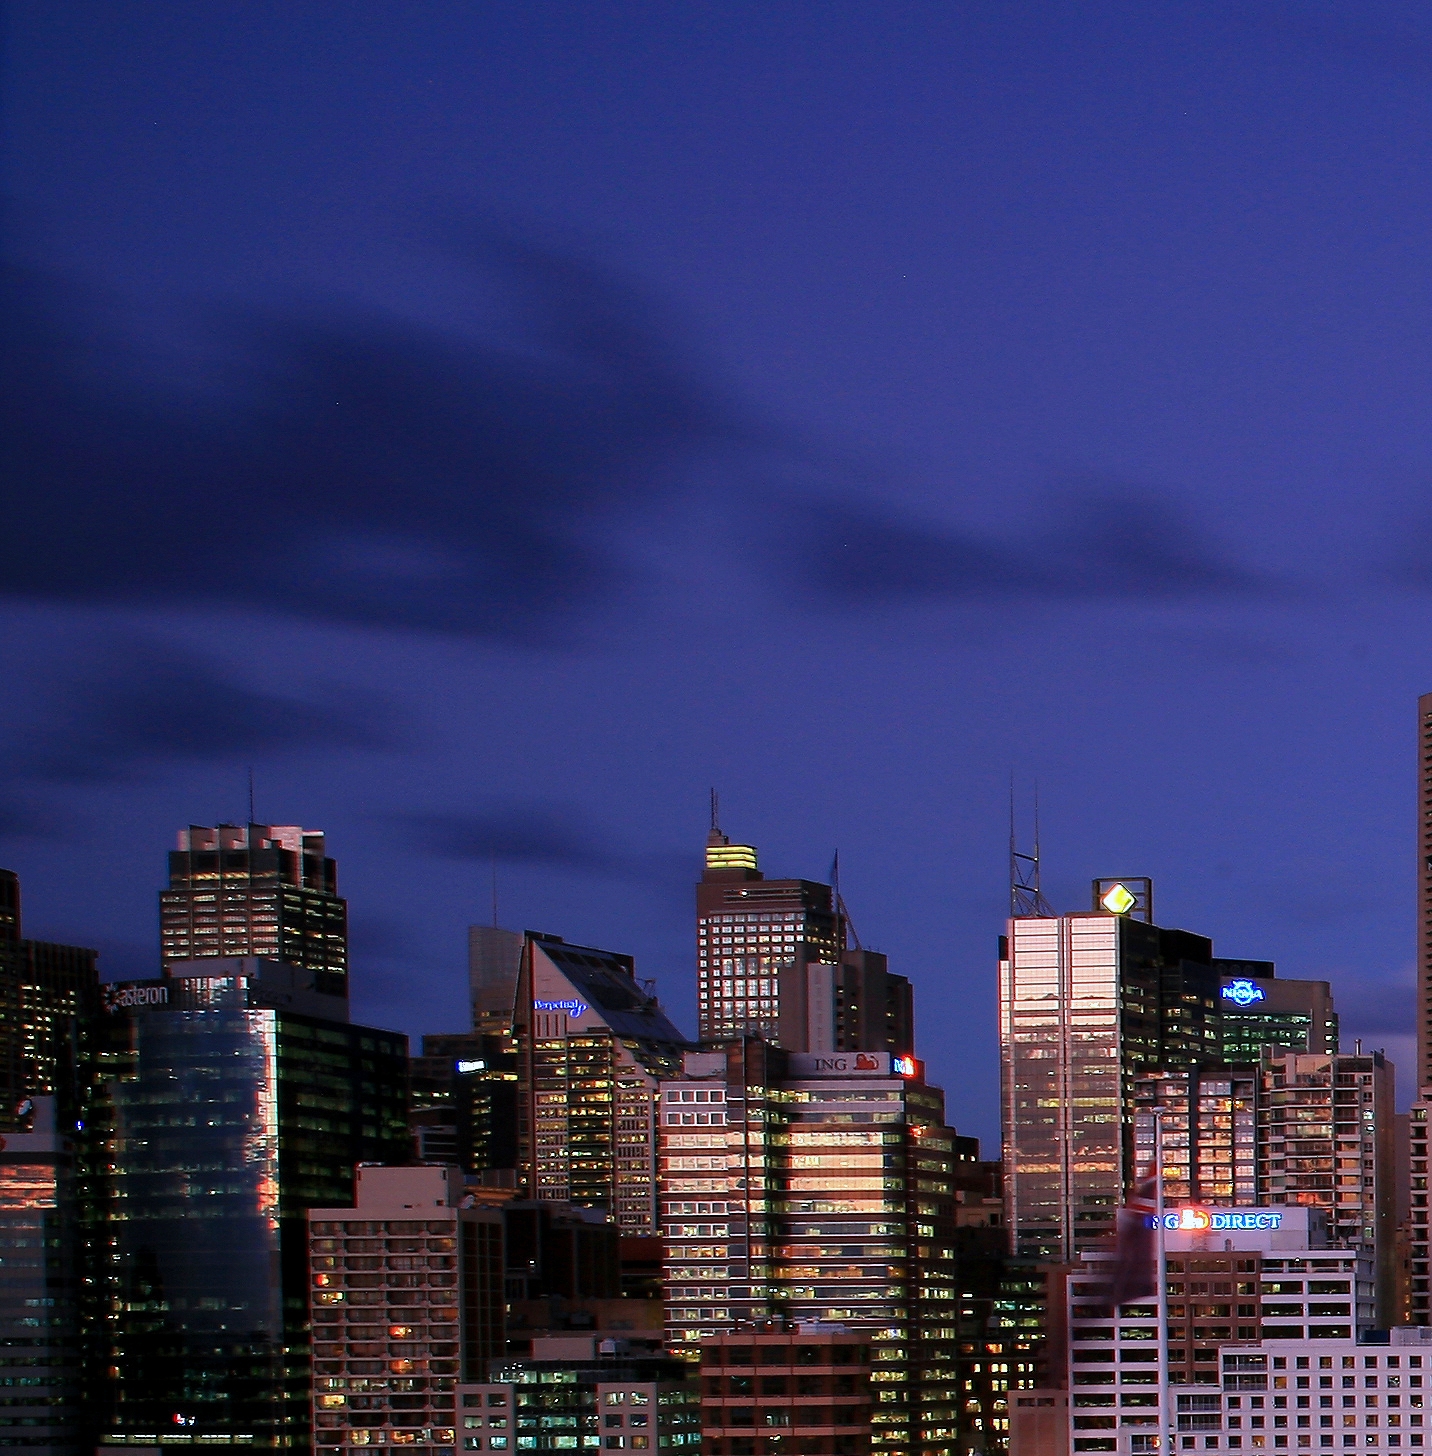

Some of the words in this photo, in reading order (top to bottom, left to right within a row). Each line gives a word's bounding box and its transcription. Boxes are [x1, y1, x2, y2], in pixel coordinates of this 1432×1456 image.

[120, 985, 168, 1006] asteron
[815, 1059, 847, 1071] ING
[1211, 1213, 1282, 1229] DIRECT
